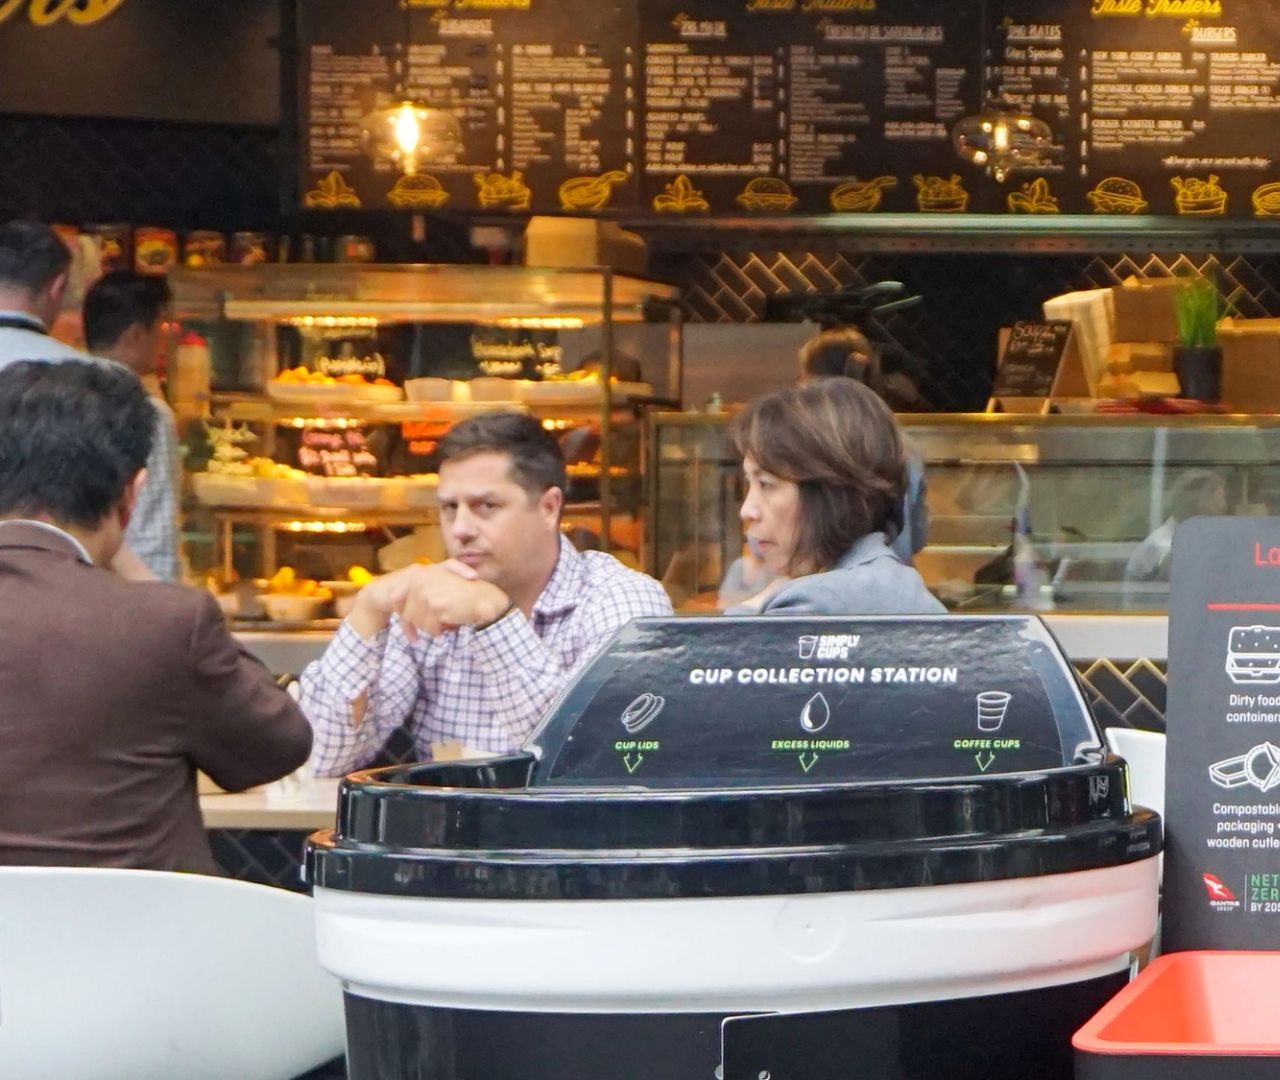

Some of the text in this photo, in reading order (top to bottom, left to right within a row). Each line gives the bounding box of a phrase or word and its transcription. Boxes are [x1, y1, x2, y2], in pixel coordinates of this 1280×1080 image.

[818, 633, 862, 647] SIMPLY
[817, 646, 850, 660] CUPS
[690, 667, 957, 684] CUP COLLECTION STATION
[1230, 695, 1255, 708] Dirty
[811, 740, 849, 749] LIQUIDS
[954, 740, 1020, 748] COFFEE CUPS
[1252, 874, 1279, 886] NET
[1251, 902, 1262, 911] BY
